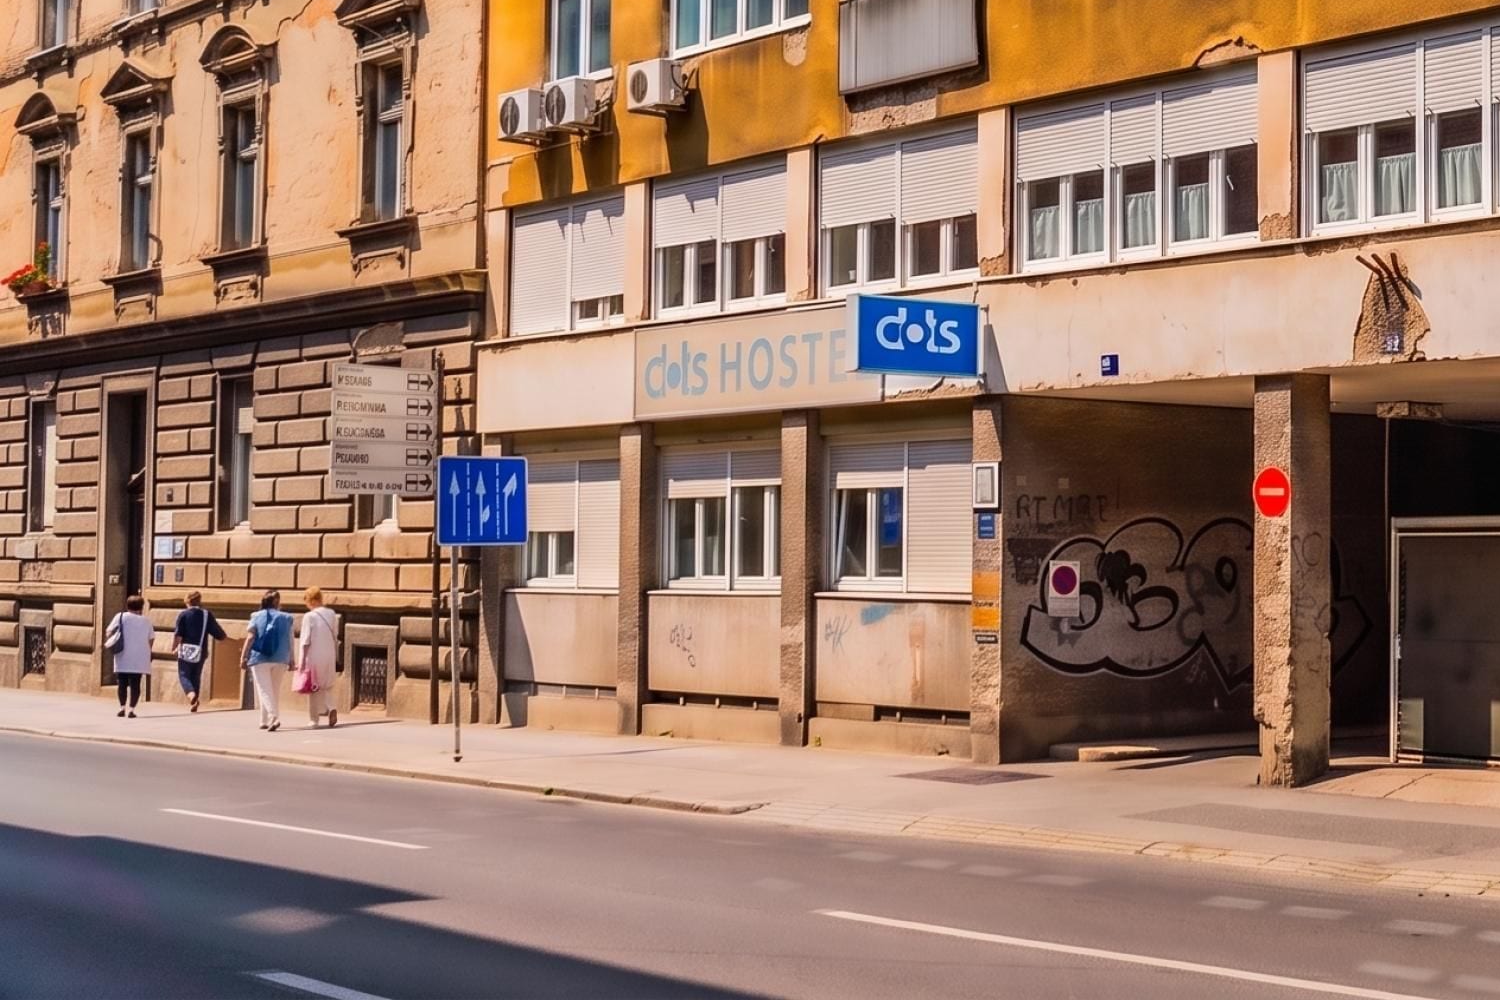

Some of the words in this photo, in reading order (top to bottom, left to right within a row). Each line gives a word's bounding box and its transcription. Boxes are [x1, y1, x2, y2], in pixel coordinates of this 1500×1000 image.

[876, 307, 961, 355] dots
[643, 340, 709, 398] dots
[720, 328, 876, 393] HOSTE
